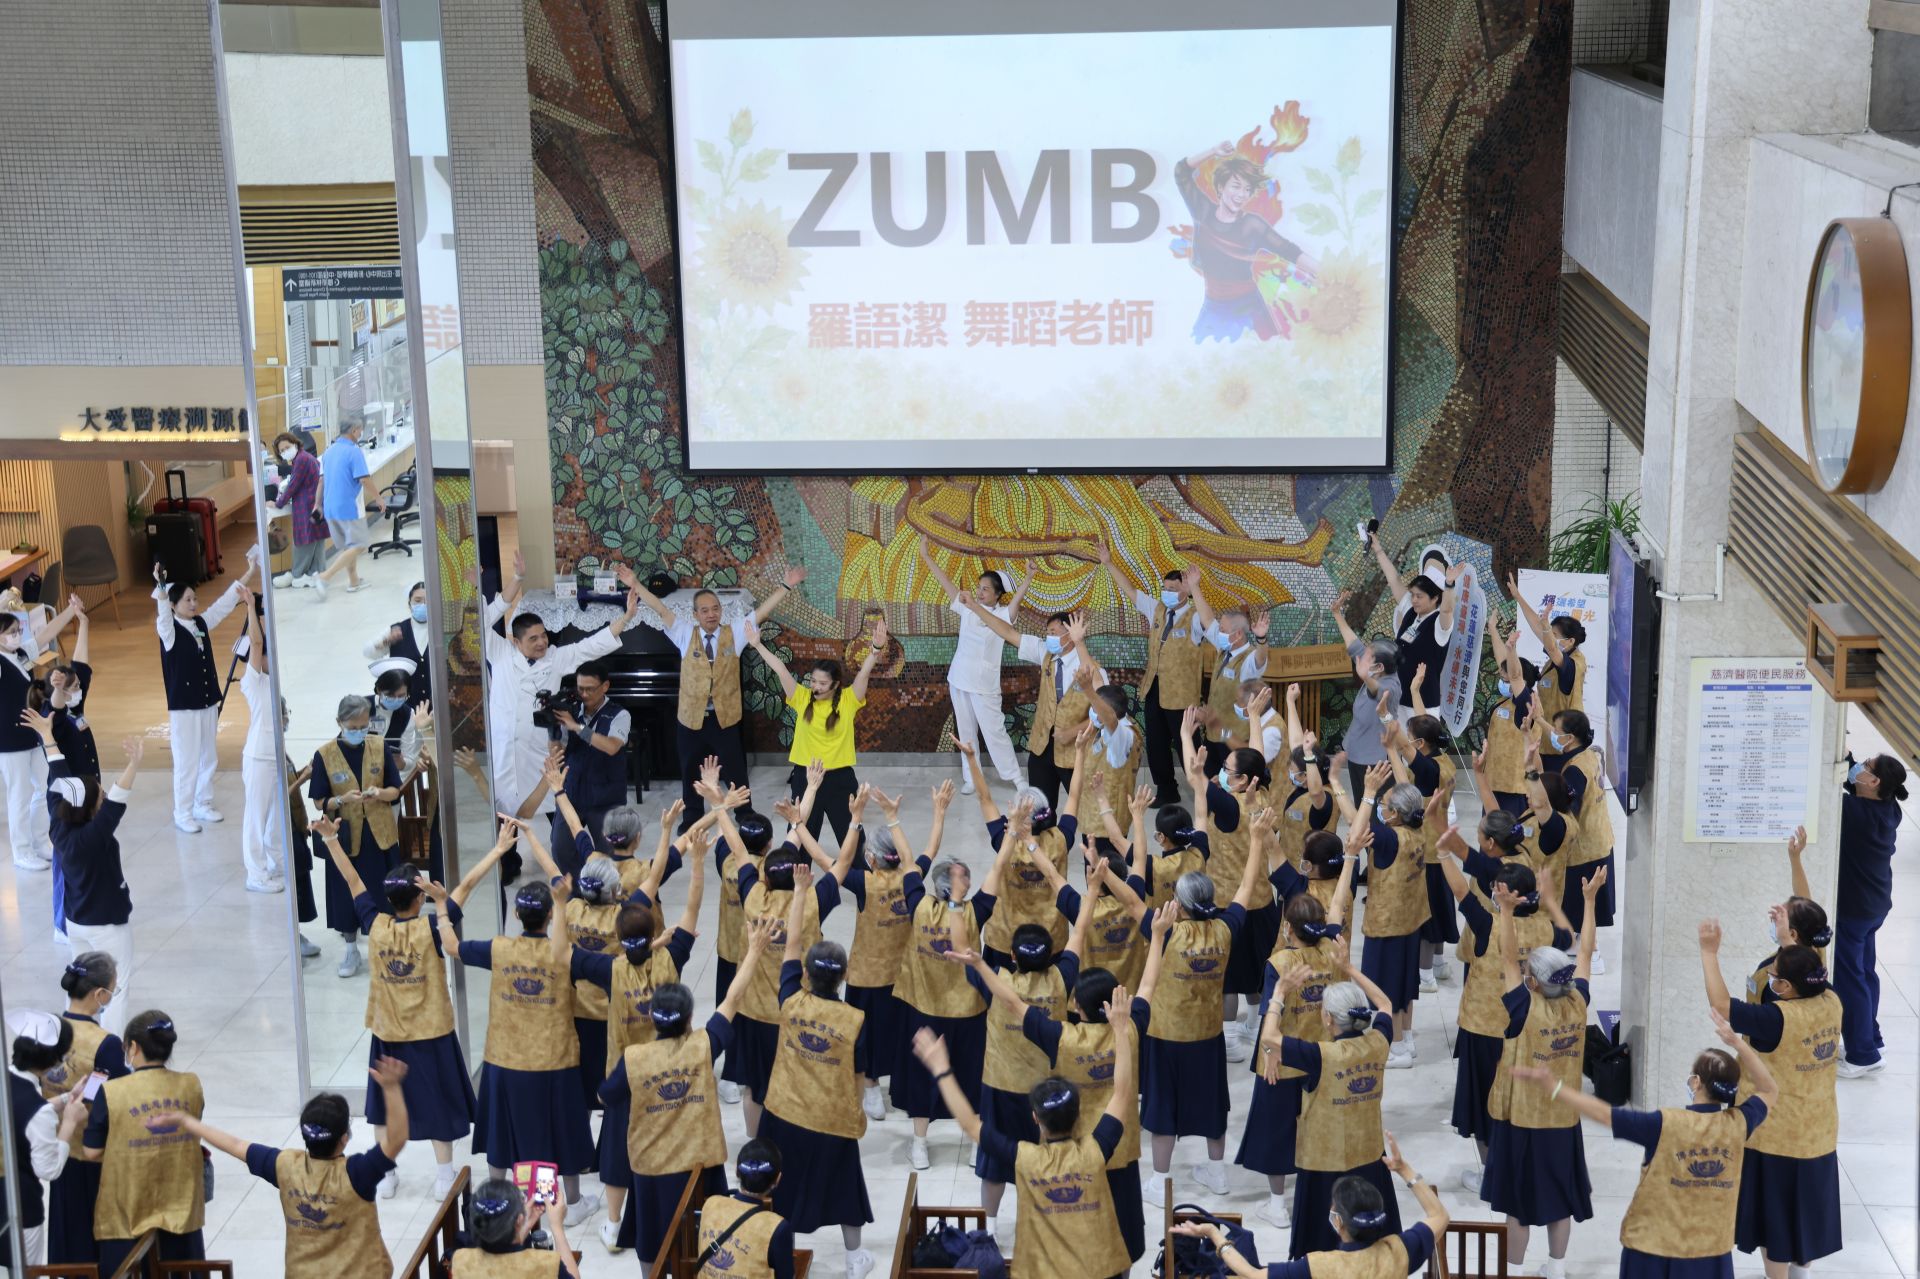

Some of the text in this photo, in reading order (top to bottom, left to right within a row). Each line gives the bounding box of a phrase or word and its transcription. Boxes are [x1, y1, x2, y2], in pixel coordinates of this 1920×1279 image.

[807, 298, 1155, 349] 羅語潔 舞蹈老師
[1710, 668, 1806, 680] 慈濟醫院便民服務
